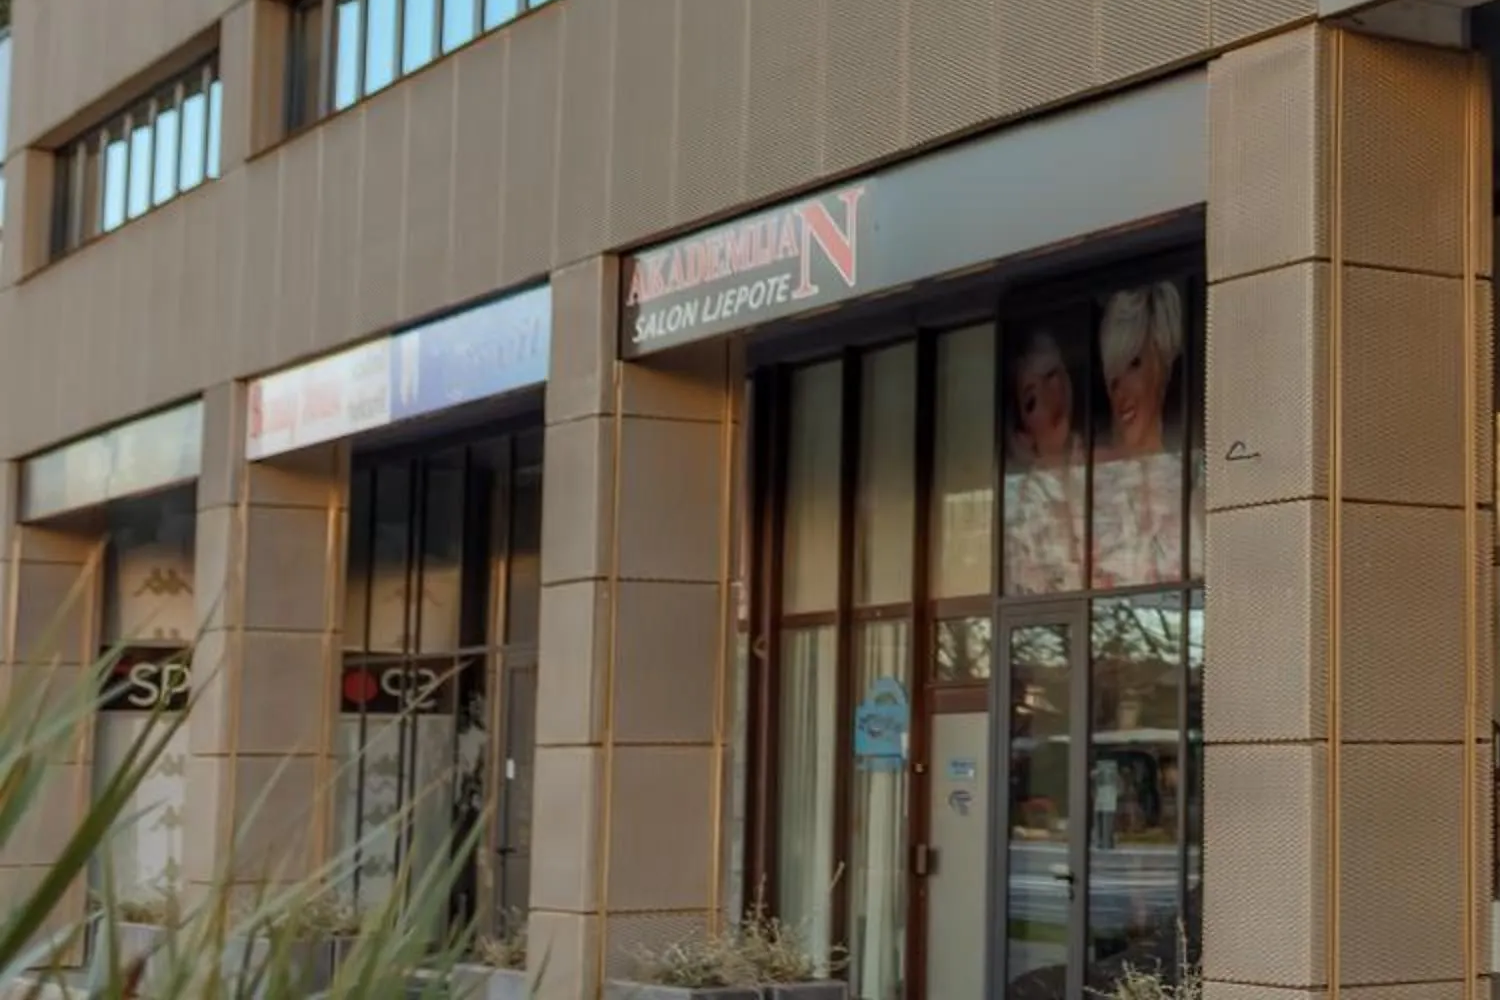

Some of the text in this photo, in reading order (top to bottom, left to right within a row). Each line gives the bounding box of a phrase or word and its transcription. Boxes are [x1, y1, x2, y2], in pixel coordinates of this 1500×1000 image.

[792, 187, 866, 300] N
[632, 273, 792, 343] SALON LJEPOTE
